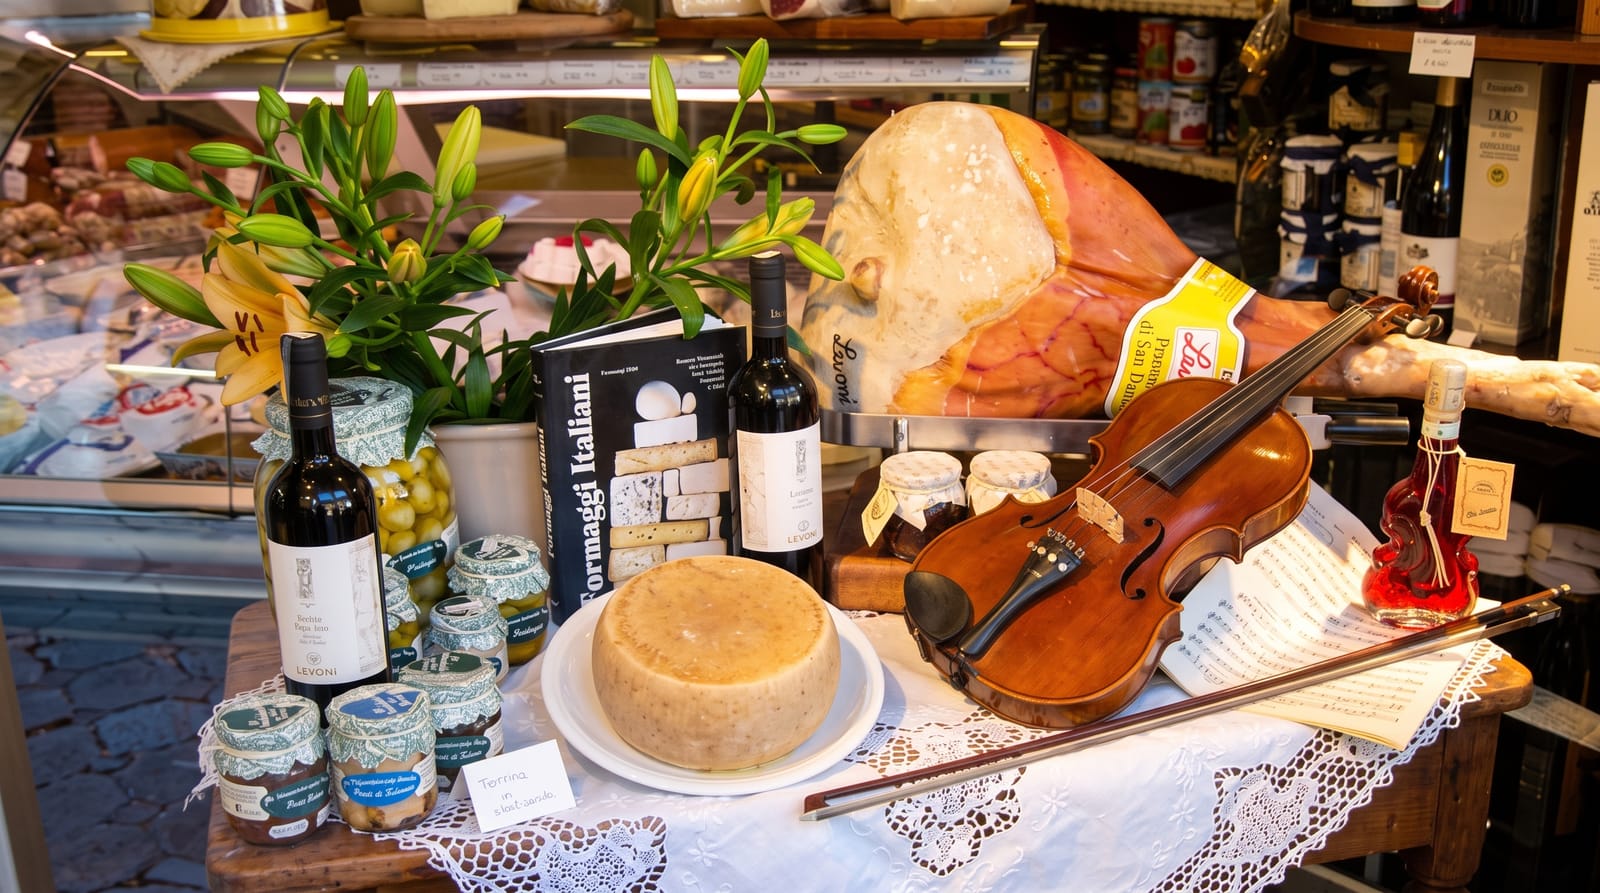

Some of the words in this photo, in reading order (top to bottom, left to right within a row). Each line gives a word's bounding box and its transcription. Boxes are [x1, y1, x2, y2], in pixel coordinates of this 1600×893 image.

[1139, 319, 1155, 336] di
[1132, 340, 1152, 367] San
[563, 372, 597, 476] Italiani
[536, 426, 548, 485] Italiani
[572, 480, 607, 608] Formaggi
[501, 791, 513, 801] in
